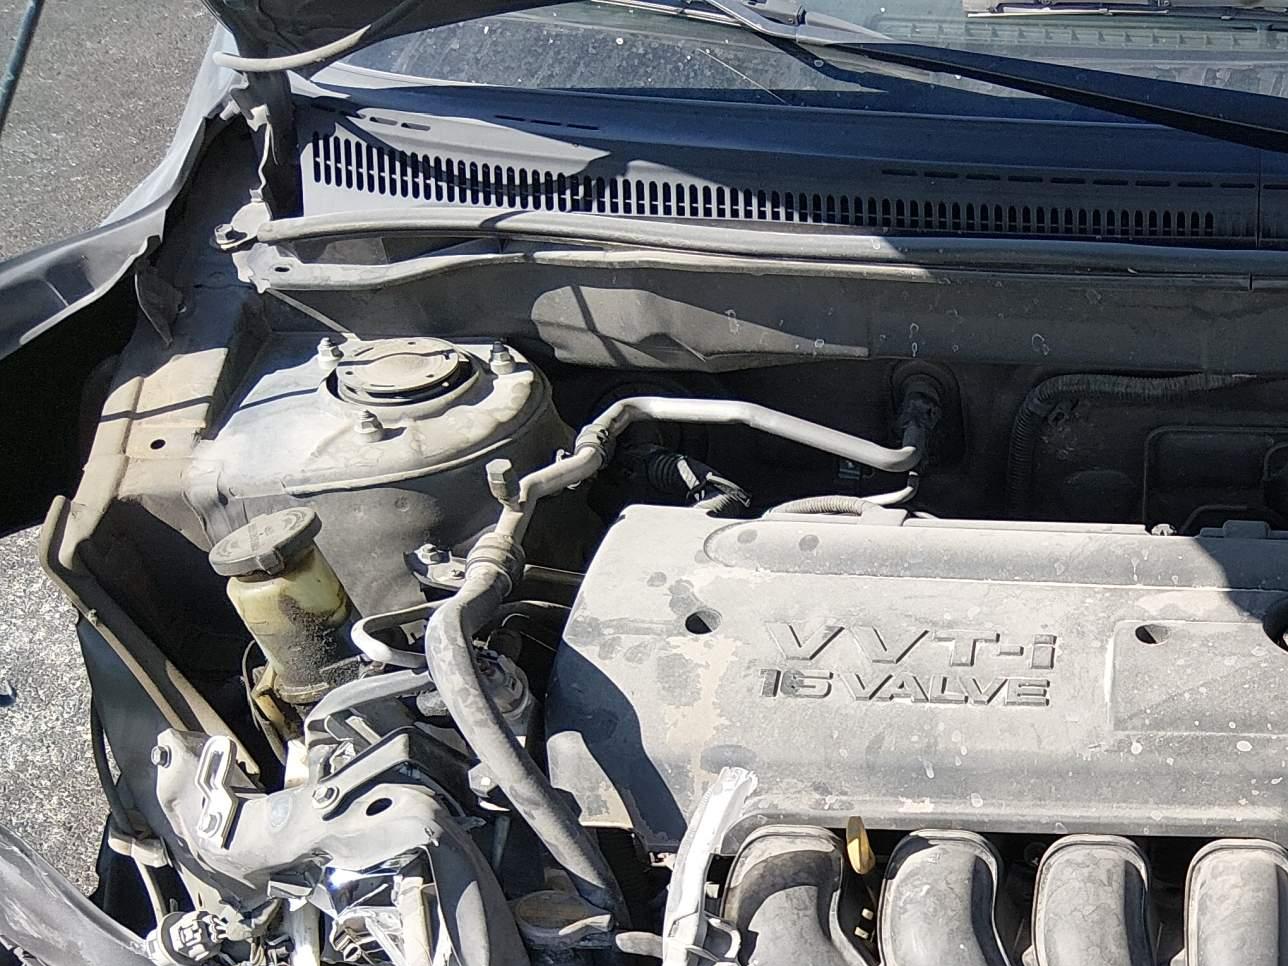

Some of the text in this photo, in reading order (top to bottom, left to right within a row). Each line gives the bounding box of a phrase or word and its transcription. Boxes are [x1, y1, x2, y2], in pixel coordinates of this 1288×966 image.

[764, 621, 1057, 669] VVT-i
[759, 669, 1050, 706] 16 VALVE
